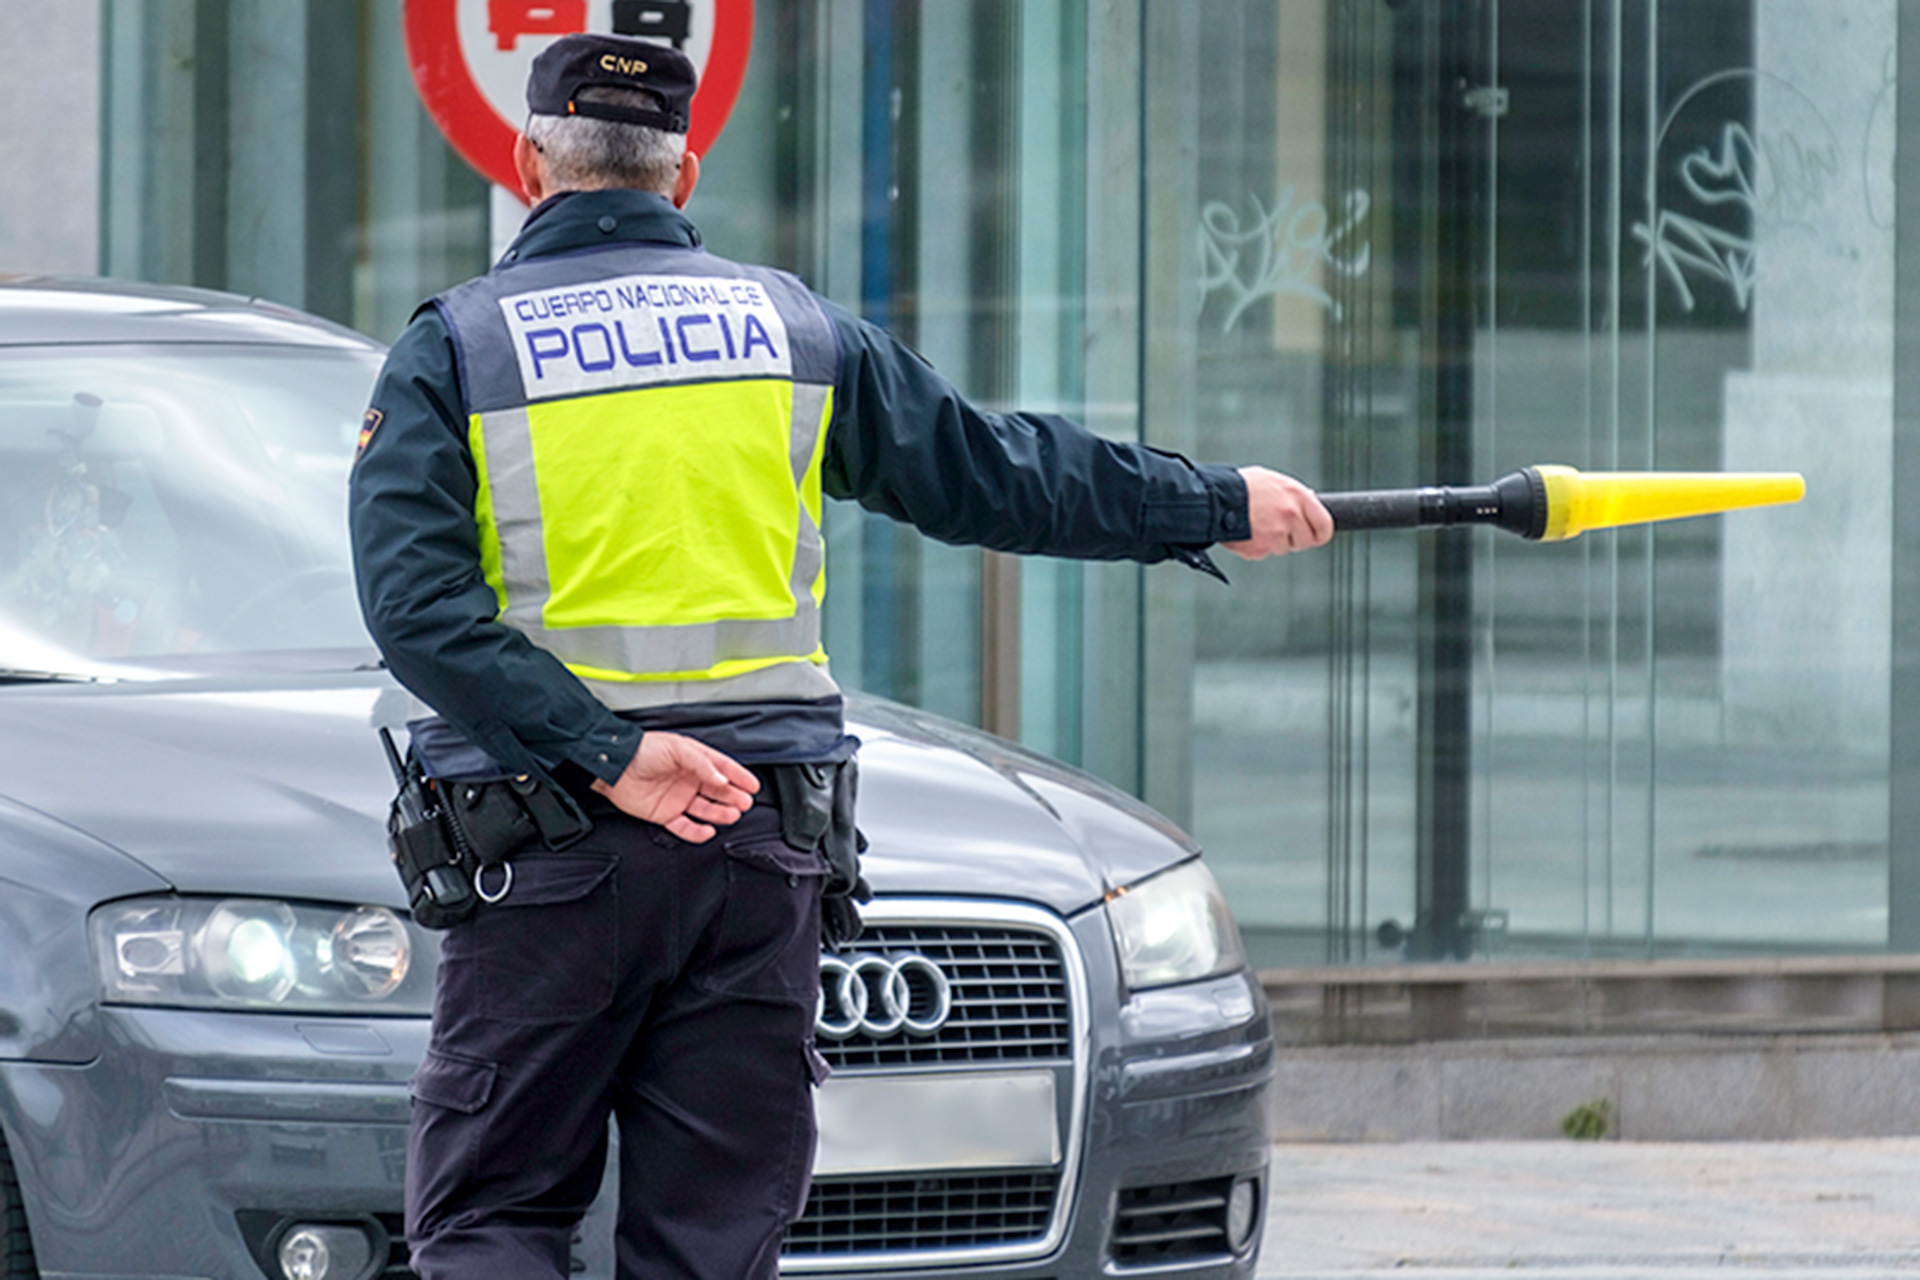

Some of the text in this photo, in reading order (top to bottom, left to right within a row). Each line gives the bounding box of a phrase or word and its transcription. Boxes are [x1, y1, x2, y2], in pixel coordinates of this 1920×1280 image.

[601, 55, 648, 75] CNP
[515, 289, 613, 321] CUERPO
[616, 284, 729, 309] NACIONAL
[525, 314, 778, 379] POLICIA
